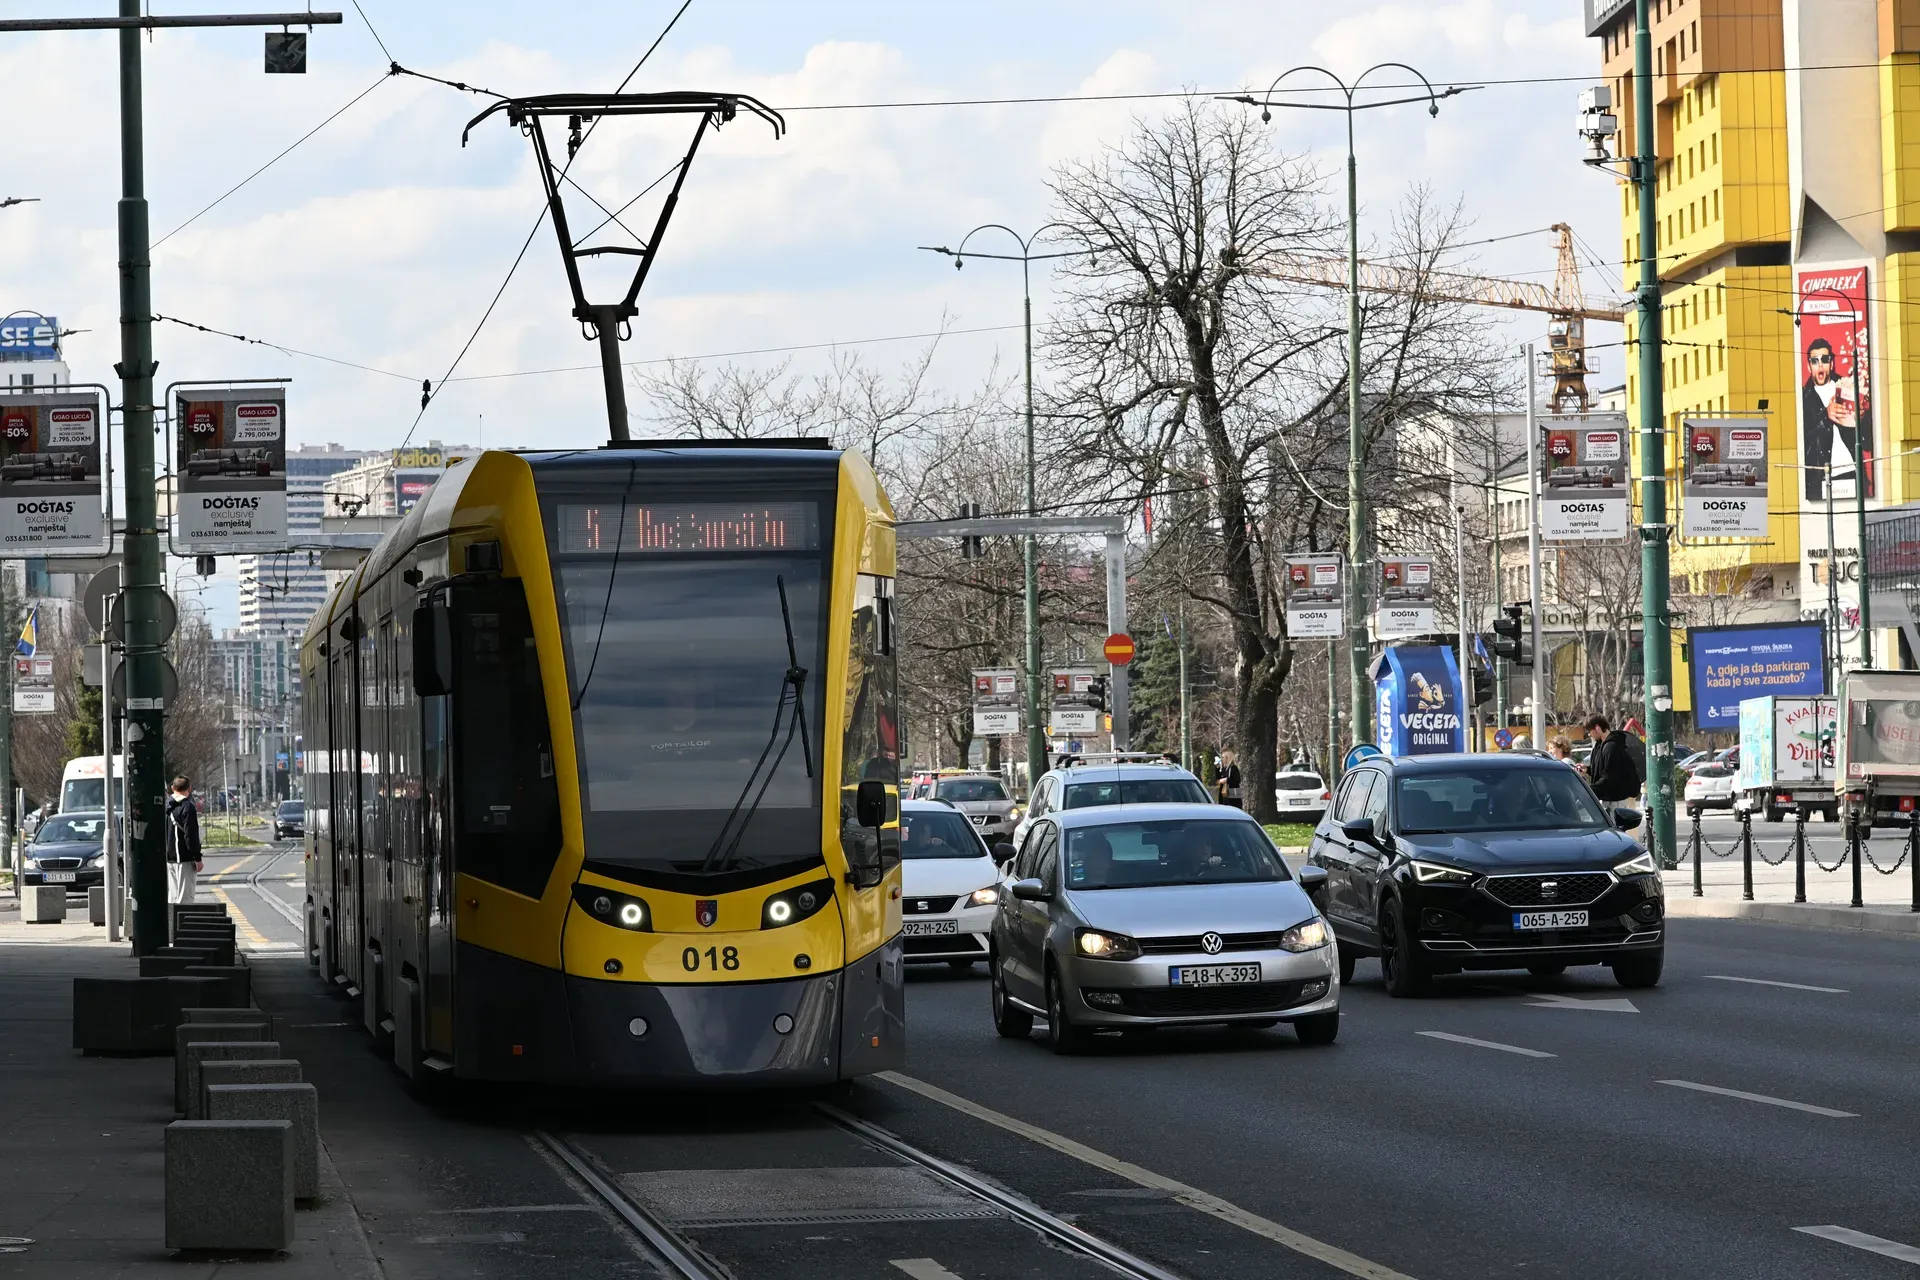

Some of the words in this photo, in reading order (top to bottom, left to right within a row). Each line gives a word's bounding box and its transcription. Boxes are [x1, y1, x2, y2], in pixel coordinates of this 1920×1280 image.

[1802, 271, 1862, 292] CINEPLEXX
[7, 428, 28, 437] 50%
[193, 423, 215, 432] 50%
[25, 515, 69, 524] exclusive
[210, 510, 254, 518] exclusive
[28, 524, 66, 533] namještaj
[214, 520, 251, 528] namještaj
[1706, 665, 1715, 676] A,
[1718, 664, 1738, 677] gdje
[1740, 664, 1750, 676] ja
[1752, 663, 1764, 673] da
[1766, 661, 1810, 674] parkiram
[1707, 677, 1730, 688] kada
[1732, 677, 1741, 688] je
[1744, 677, 1760, 686] sve
[1763, 672, 1805, 684] zauzeto?
[1400, 714, 1460, 731] VEGETA
[1413, 733, 1448, 745] ORIGINAL
[1522, 912, 1586, 927] 065-A-259
[682, 946, 740, 972] 018
[1181, 967, 1258, 983] E18-K-393
